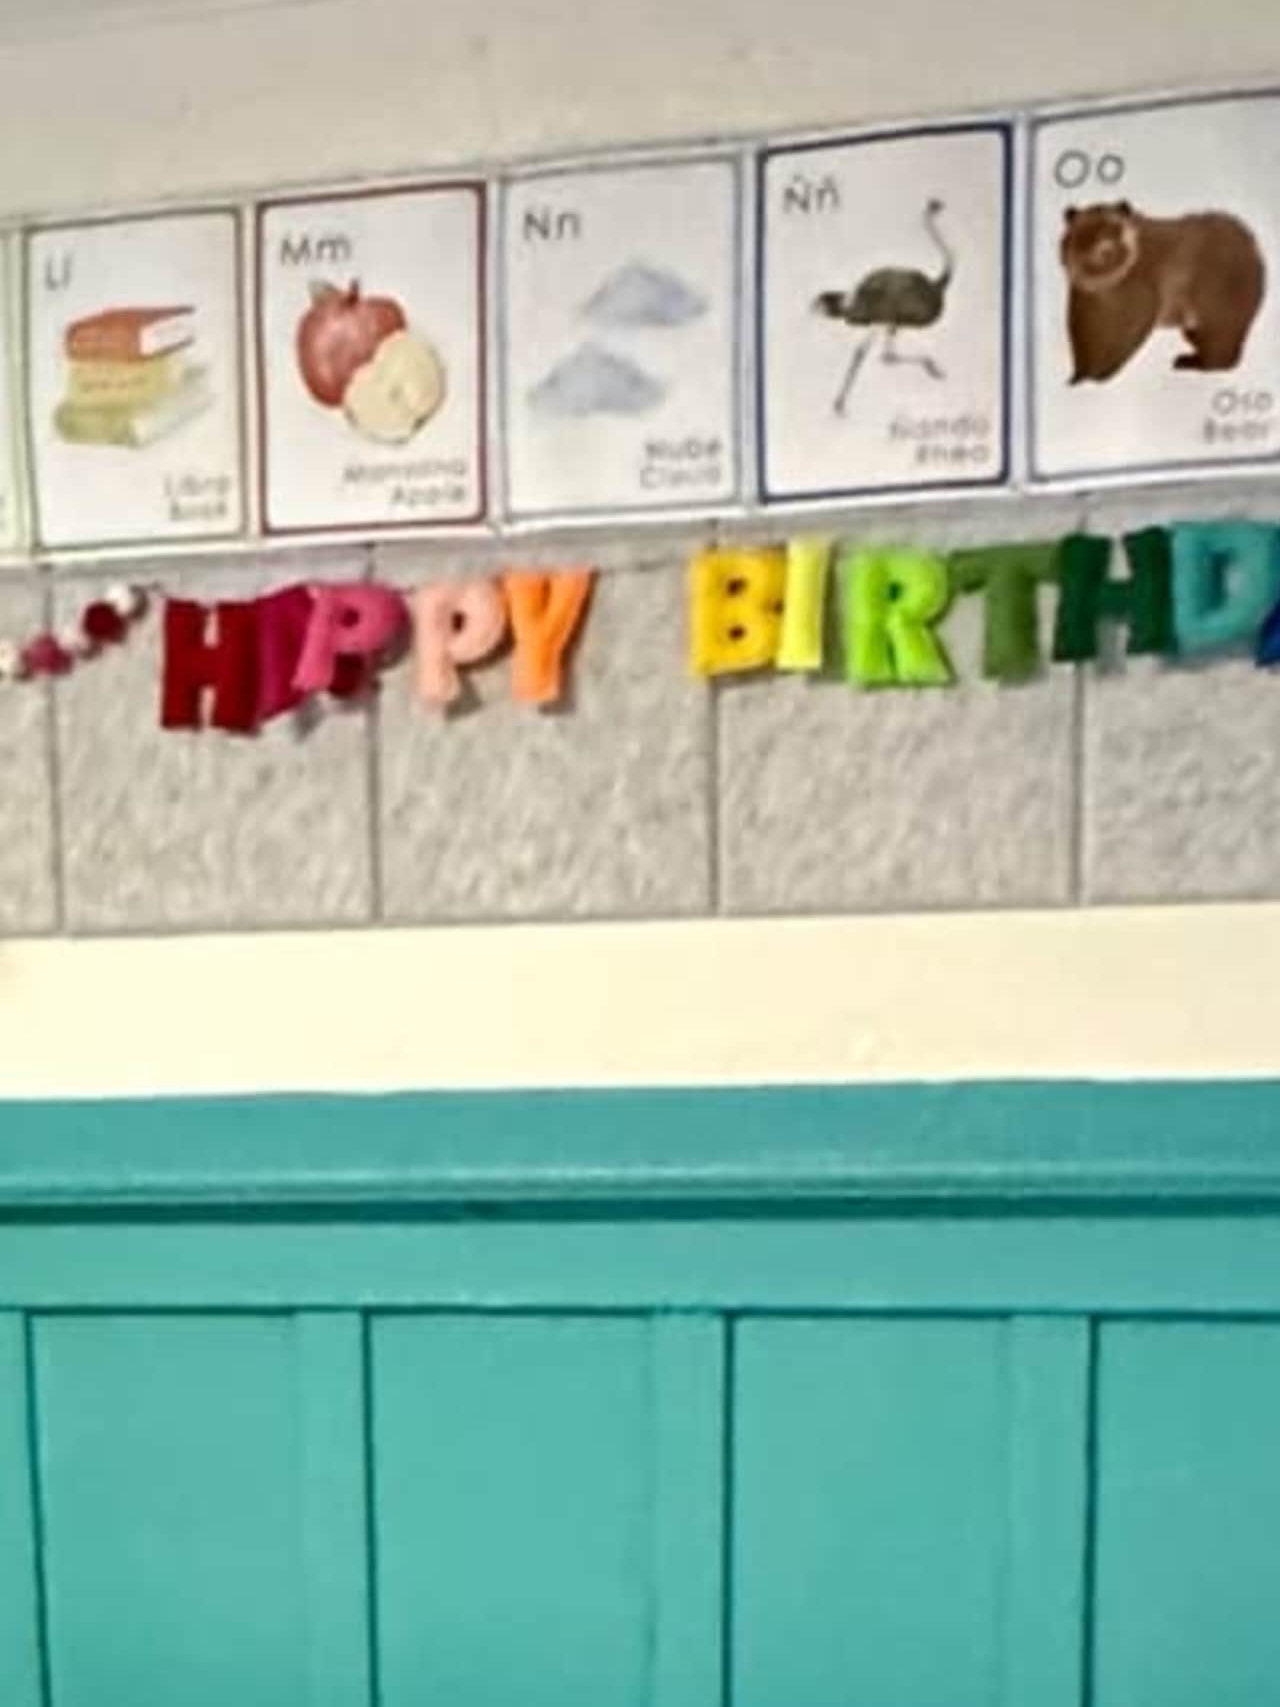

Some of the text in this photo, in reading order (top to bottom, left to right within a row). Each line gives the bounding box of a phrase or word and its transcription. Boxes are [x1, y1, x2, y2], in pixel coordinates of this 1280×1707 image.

[1053, 149, 1125, 189] Oo
[523, 208, 580, 241] Nn
[280, 235, 352, 265] Mm
[1211, 390, 1273, 416] Oso
[1203, 418, 1271, 443] Bear
[643, 436, 723, 461] Nube
[160, 568, 596, 734] HAPPY
